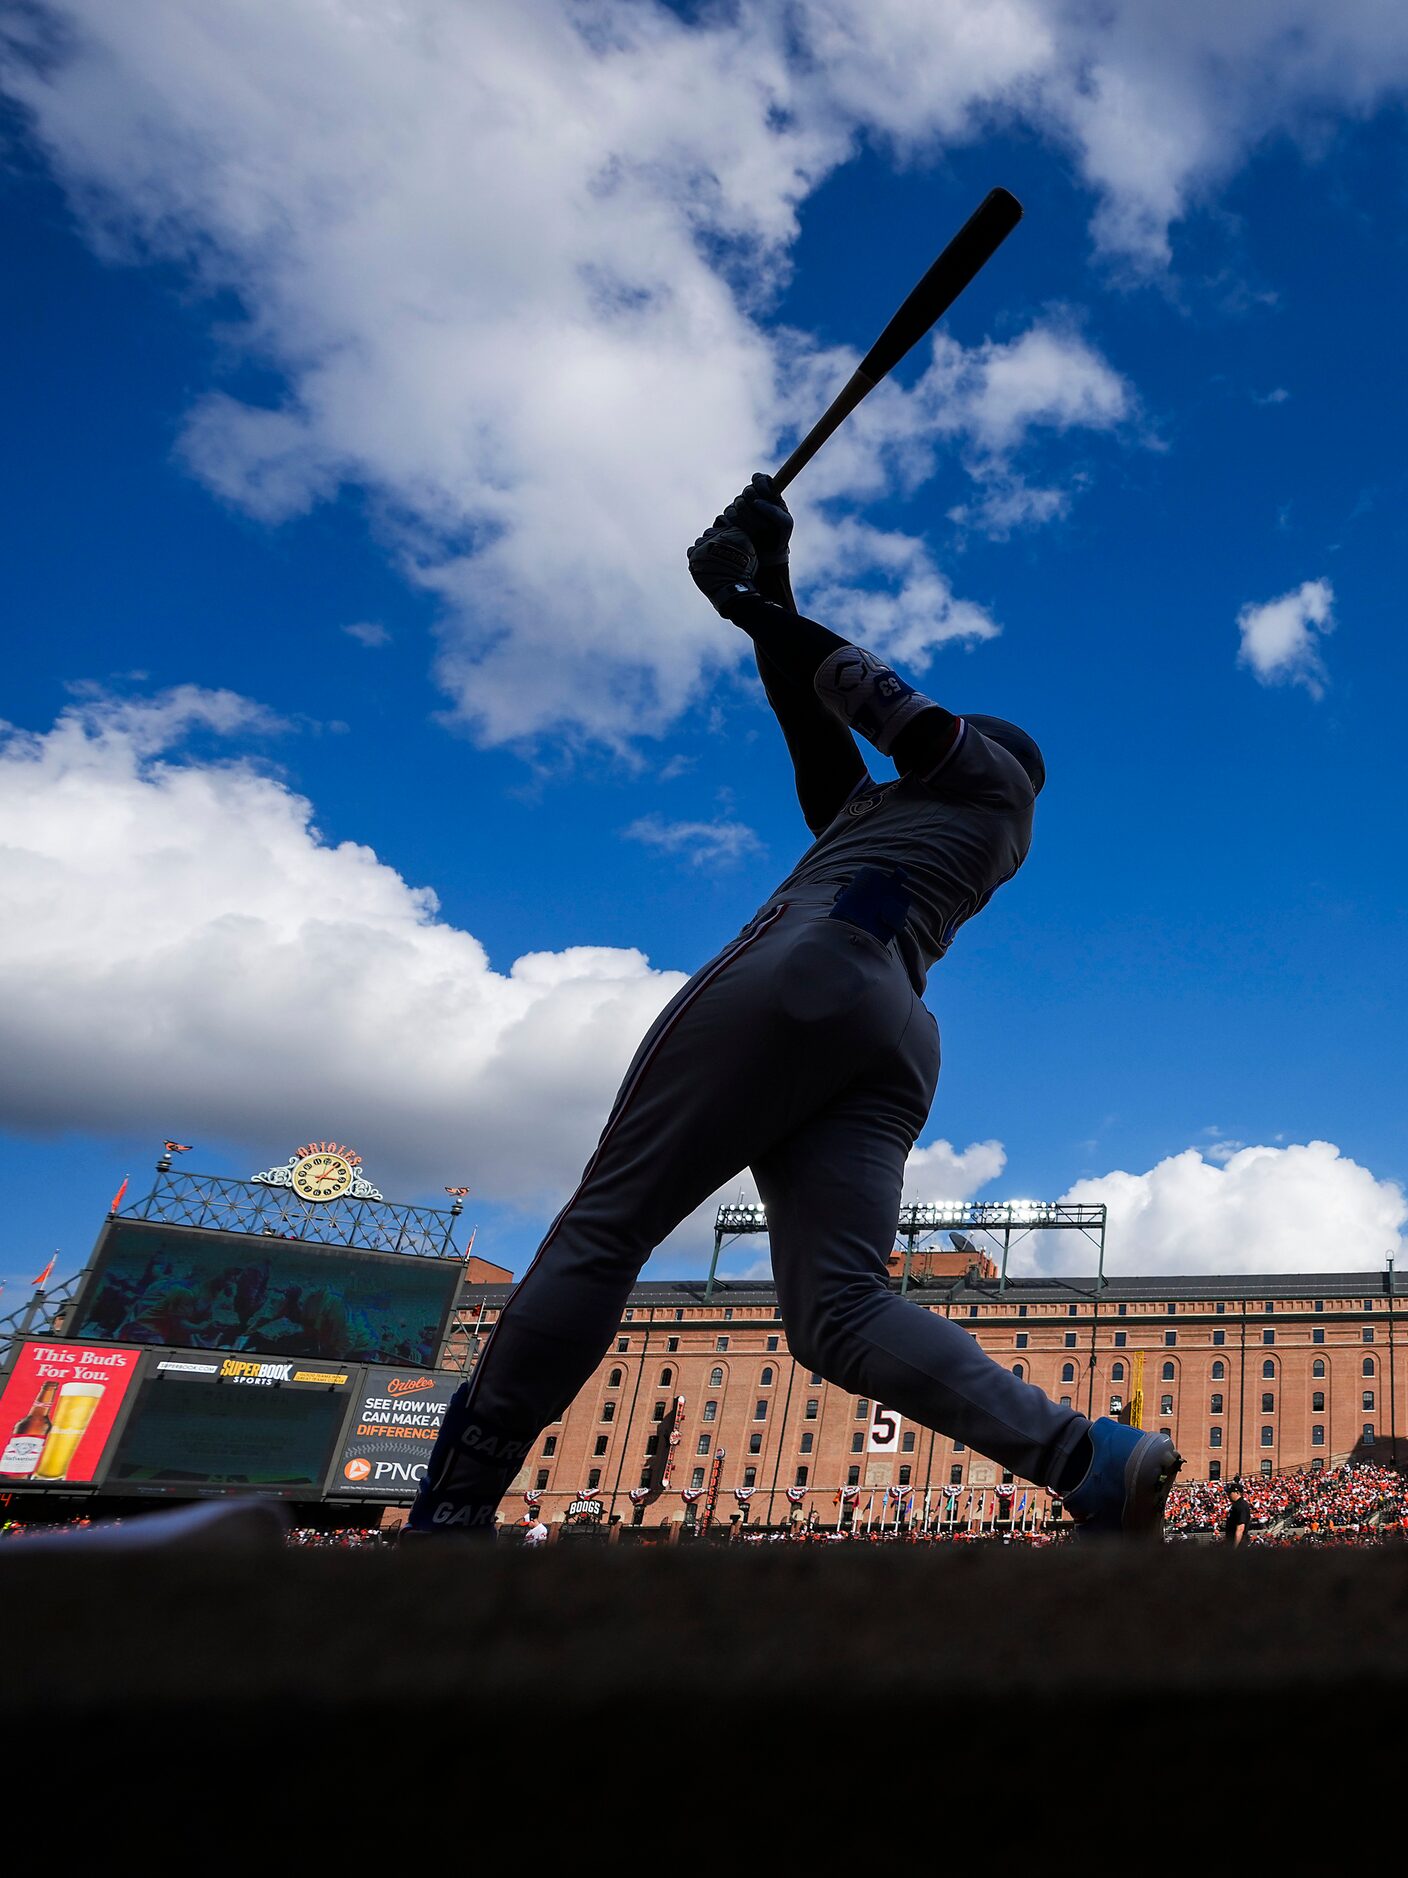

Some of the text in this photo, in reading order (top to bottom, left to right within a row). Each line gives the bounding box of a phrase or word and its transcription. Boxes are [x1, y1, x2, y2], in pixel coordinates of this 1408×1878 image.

[295, 1141, 362, 1167] ORIOLES
[33, 1347, 127, 1367] This Bud's
[36, 1364, 110, 1381] For You.
[220, 1359, 294, 1381] SUPERBOOK
[233, 1376, 273, 1386] SPORTS
[387, 1377, 435, 1397] Orioles
[365, 1398, 447, 1414] SEE HOW WE
[362, 1411, 441, 1426] CAN MAKE A
[872, 1404, 896, 1444] 5
[356, 1424, 440, 1440] DIFFERENCE
[374, 1461, 429, 1482] PNC
